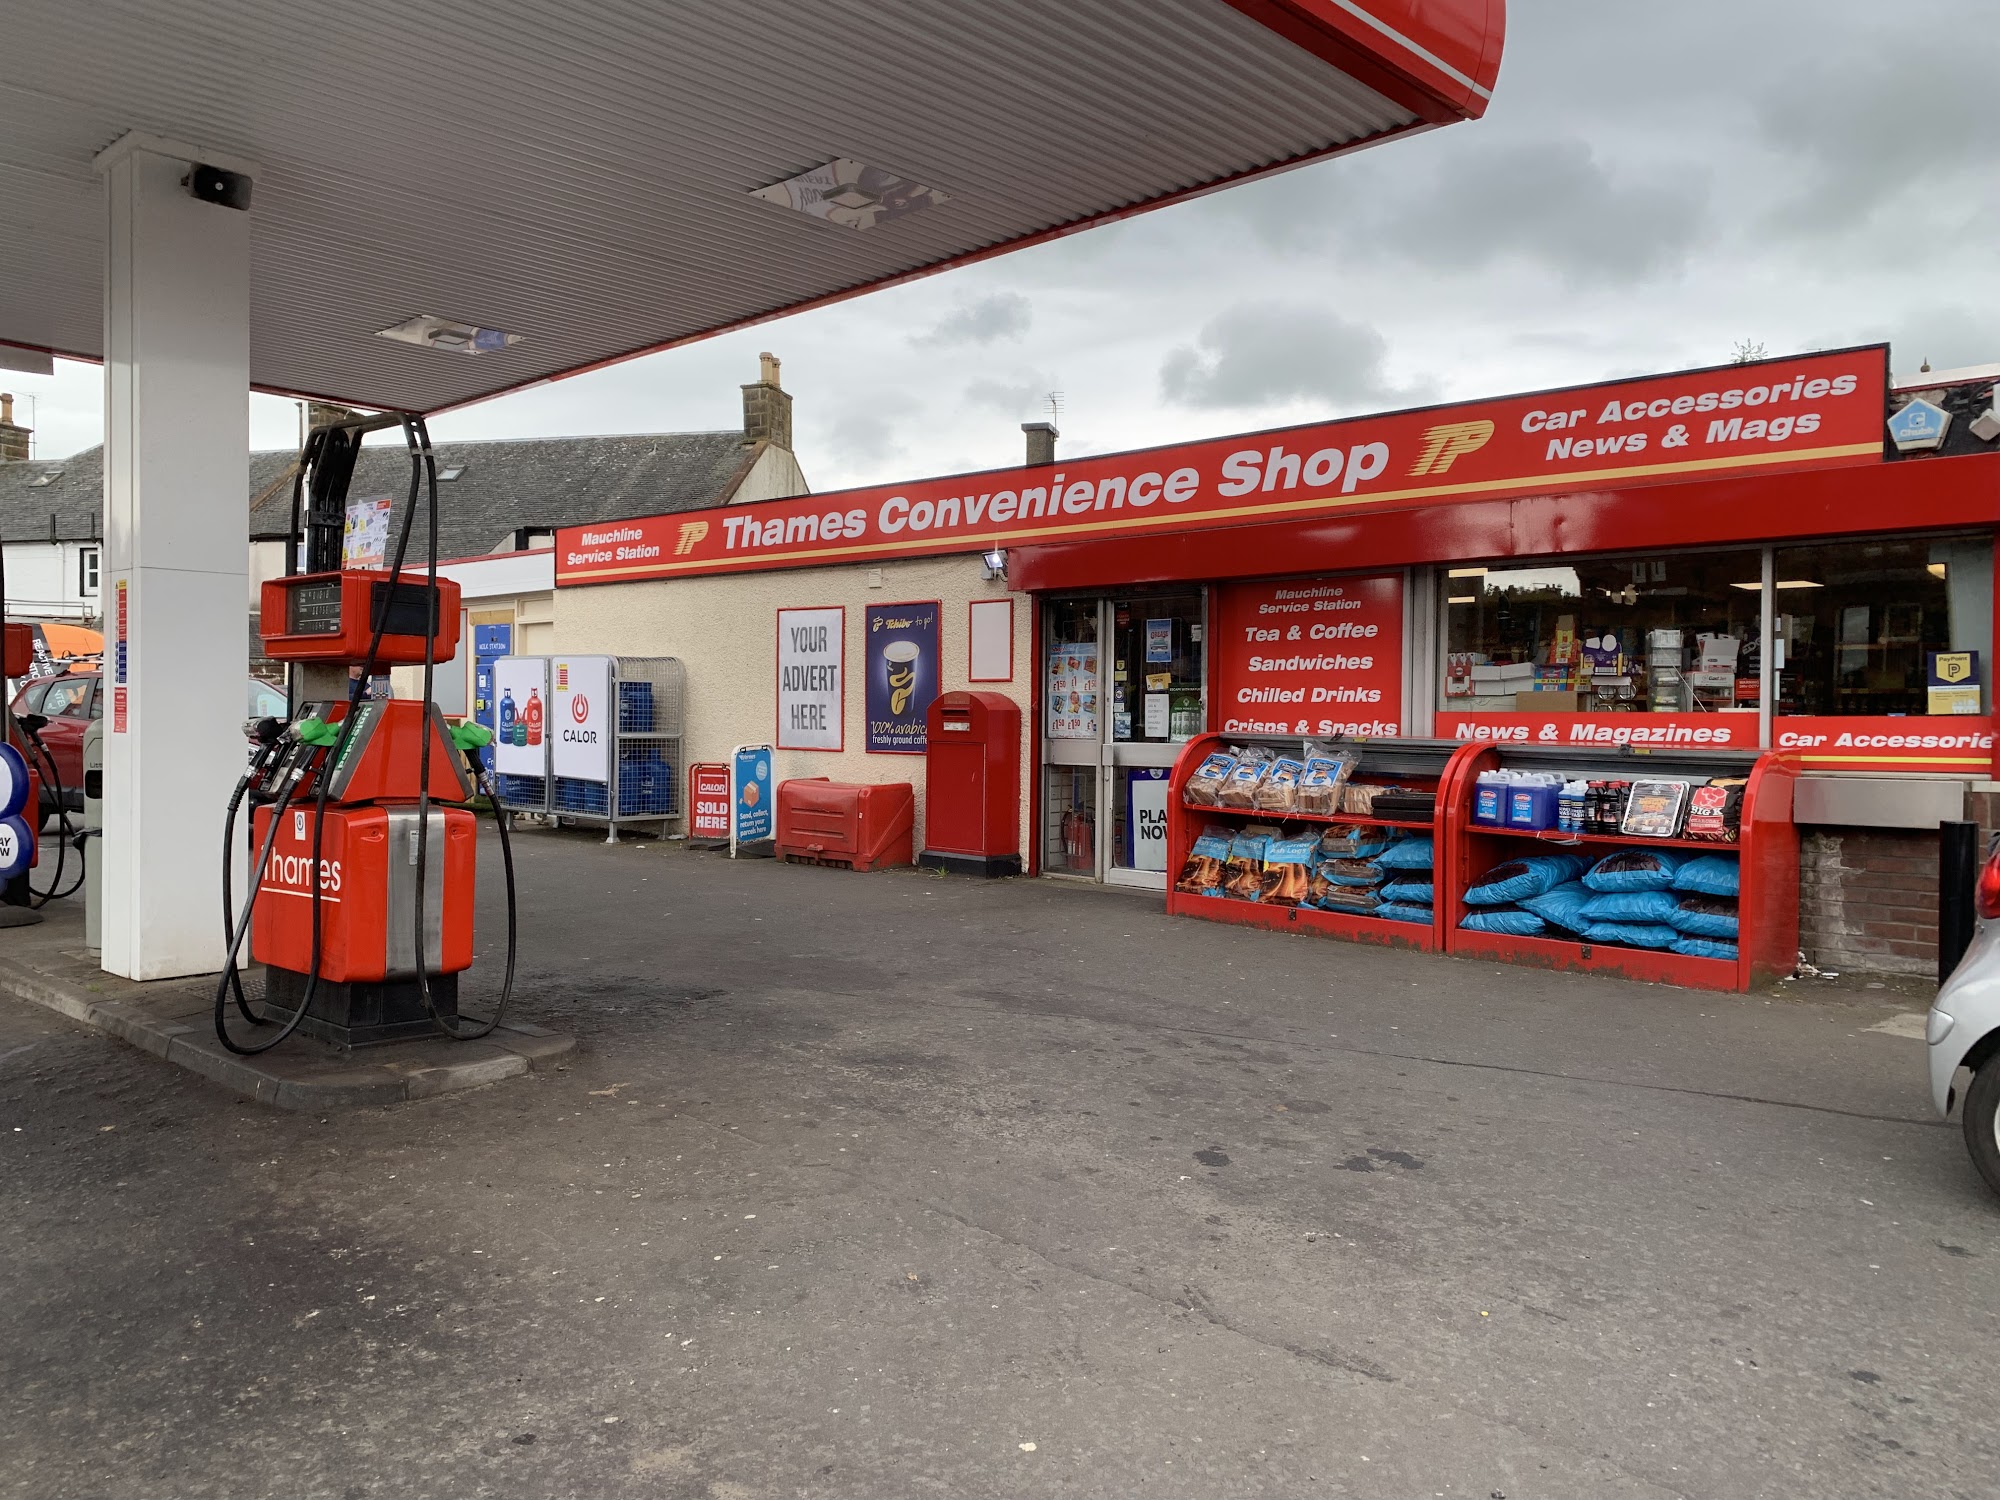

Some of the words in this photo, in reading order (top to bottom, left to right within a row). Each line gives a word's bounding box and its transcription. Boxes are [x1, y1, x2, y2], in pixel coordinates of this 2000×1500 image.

[1521, 409, 1586, 433] Car
[1597, 374, 1858, 425] Accessories
[1545, 432, 1647, 461] News
[1661, 424, 1690, 448] &
[1706, 413, 1821, 443] Mags
[722, 508, 867, 549] Thames
[878, 467, 1200, 534] Convenience
[1217, 441, 1390, 497] Shop
[581, 527, 643, 546] Mauchline
[567, 550, 613, 566] Service
[616, 544, 660, 561] Station
[1275, 586, 1343, 600] Mauchline
[1259, 601, 1309, 614] Service
[1313, 599, 1361, 611] Station
[885, 618, 913, 630] Tchibo
[915, 615, 923, 626] to
[1245, 627, 1280, 641] Tea
[1286, 625, 1302, 641] &
[1309, 622, 1378, 640] Coffee
[790, 626, 827, 653] YOUR
[1248, 654, 1374, 672] Sandwiches
[782, 665, 838, 692] ADVERT
[1237, 687, 1306, 703] Chilled
[1310, 686, 1381, 703] Drinks
[791, 704, 827, 731] HERE
[895, 718, 928, 735] arabic
[1224, 718, 1289, 733] Crisps
[1294, 719, 1310, 734] &
[1317, 719, 1398, 736] Snacks
[1455, 722, 1529, 740] News
[1538, 723, 1559, 741] &
[1569, 723, 1731, 744] Magazines
[336, 705, 372, 770] Unleaded
[563, 729, 597, 744] CALOR
[872, 734, 892, 746] freshly
[892, 736, 912, 746] ground
[914, 735, 928, 745] coffe
[1779, 732, 1827, 747] Car
[1834, 732, 1992, 749] Accessorie
[700, 783, 725, 793] CALOR
[696, 802, 728, 815] SOLD
[739, 811, 753, 820] Send,
[1691, 806, 1710, 815] BIG
[1713, 807, 1723, 815] K
[696, 816, 727, 829] HERE
[740, 820, 755, 828] return
[755, 818, 765, 827] your
[1139, 809, 1167, 824] PLA
[740, 828, 757, 838] parcels
[756, 826, 767, 834] here
[1140, 825, 1167, 840] NO
[0, 837, 11, 847] AY
[1210, 841, 1227, 850] Logs
[1246, 839, 1262, 850] Logs
[1269, 847, 1285, 855] Ash
[1286, 847, 1306, 855] Logs
